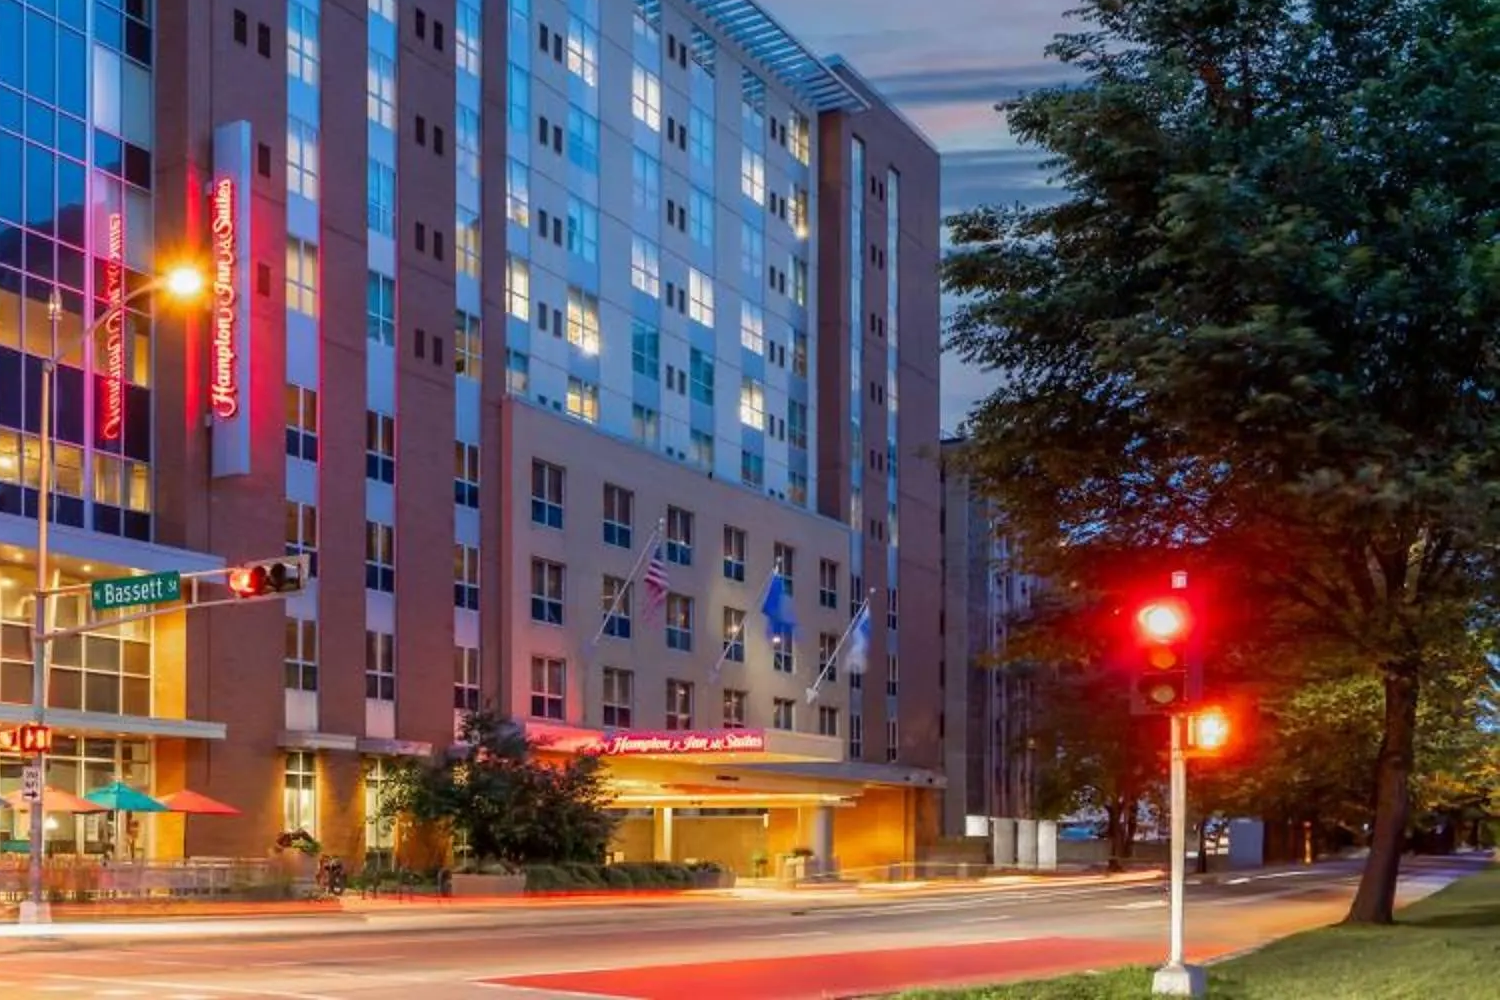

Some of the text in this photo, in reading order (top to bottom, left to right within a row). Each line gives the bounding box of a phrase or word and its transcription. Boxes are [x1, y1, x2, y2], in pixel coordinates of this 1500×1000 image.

[213, 179, 233, 237] Suites
[213, 249, 235, 308] Inn
[212, 308, 237, 417] Hampton
[105, 577, 163, 605] Bassett
[607, 735, 677, 755] Hampton
[673, 735, 710, 751] Inn
[722, 733, 763, 749] Suites
